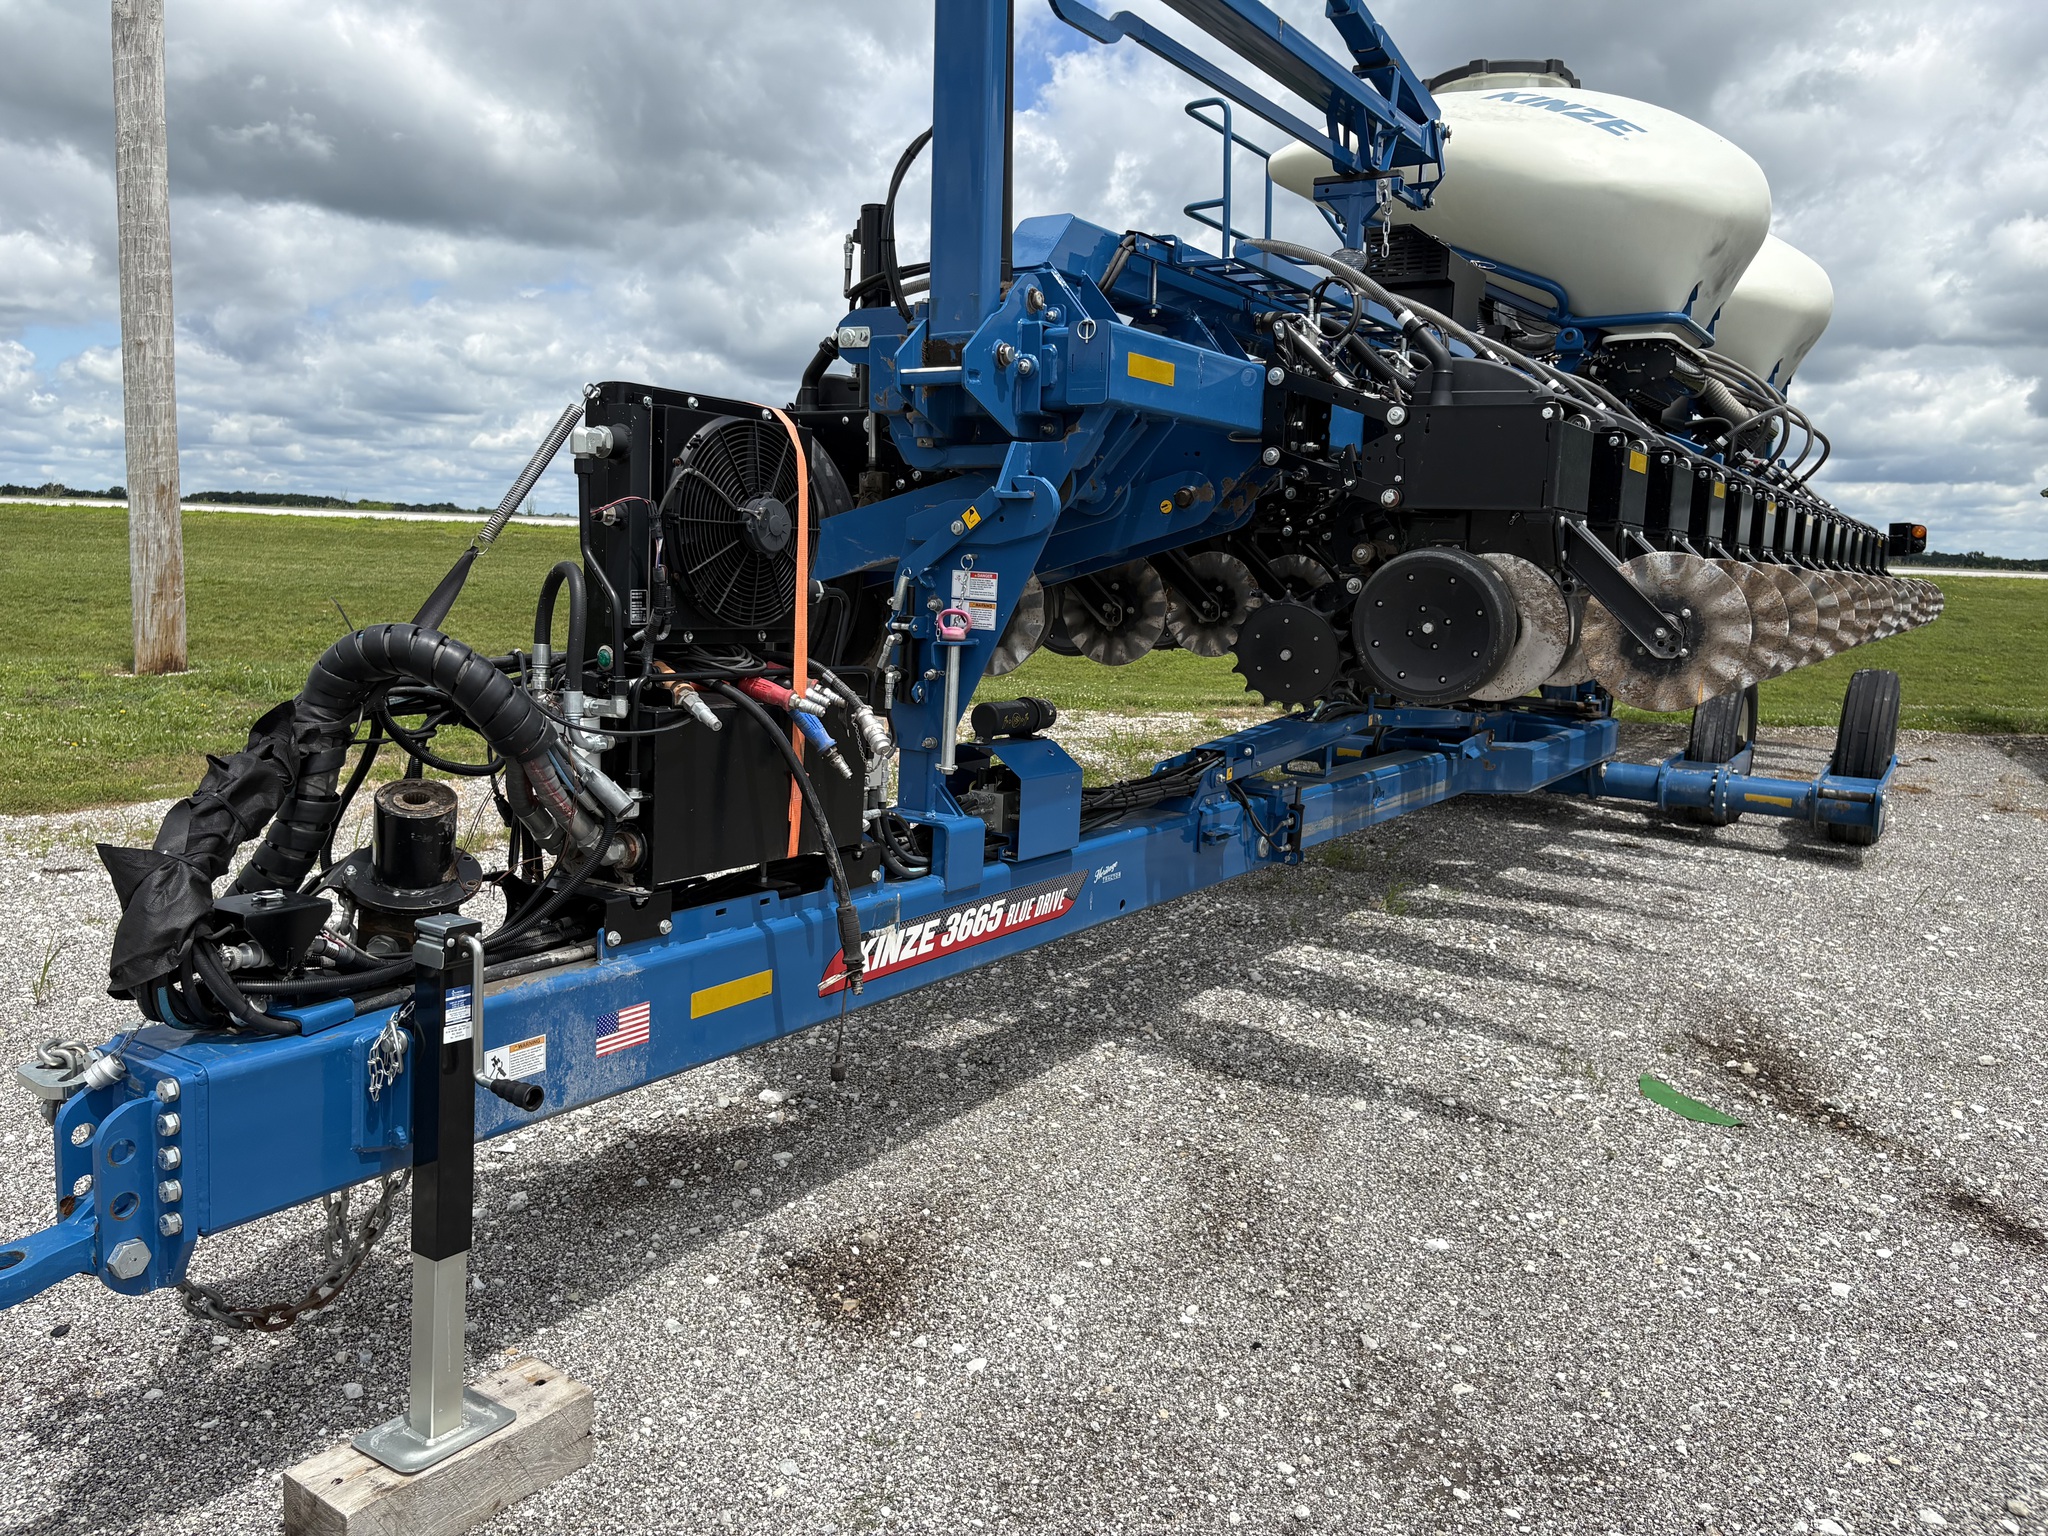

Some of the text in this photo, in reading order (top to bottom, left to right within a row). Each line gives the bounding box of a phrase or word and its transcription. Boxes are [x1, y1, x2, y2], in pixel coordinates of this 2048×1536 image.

[1480, 92, 1648, 137] KINZE
[941, 899, 1006, 947] 3665
[1005, 897, 1035, 927] BLUE
[1034, 888, 1068, 918] DRIVE
[518, 1038, 541, 1049] WARNING
